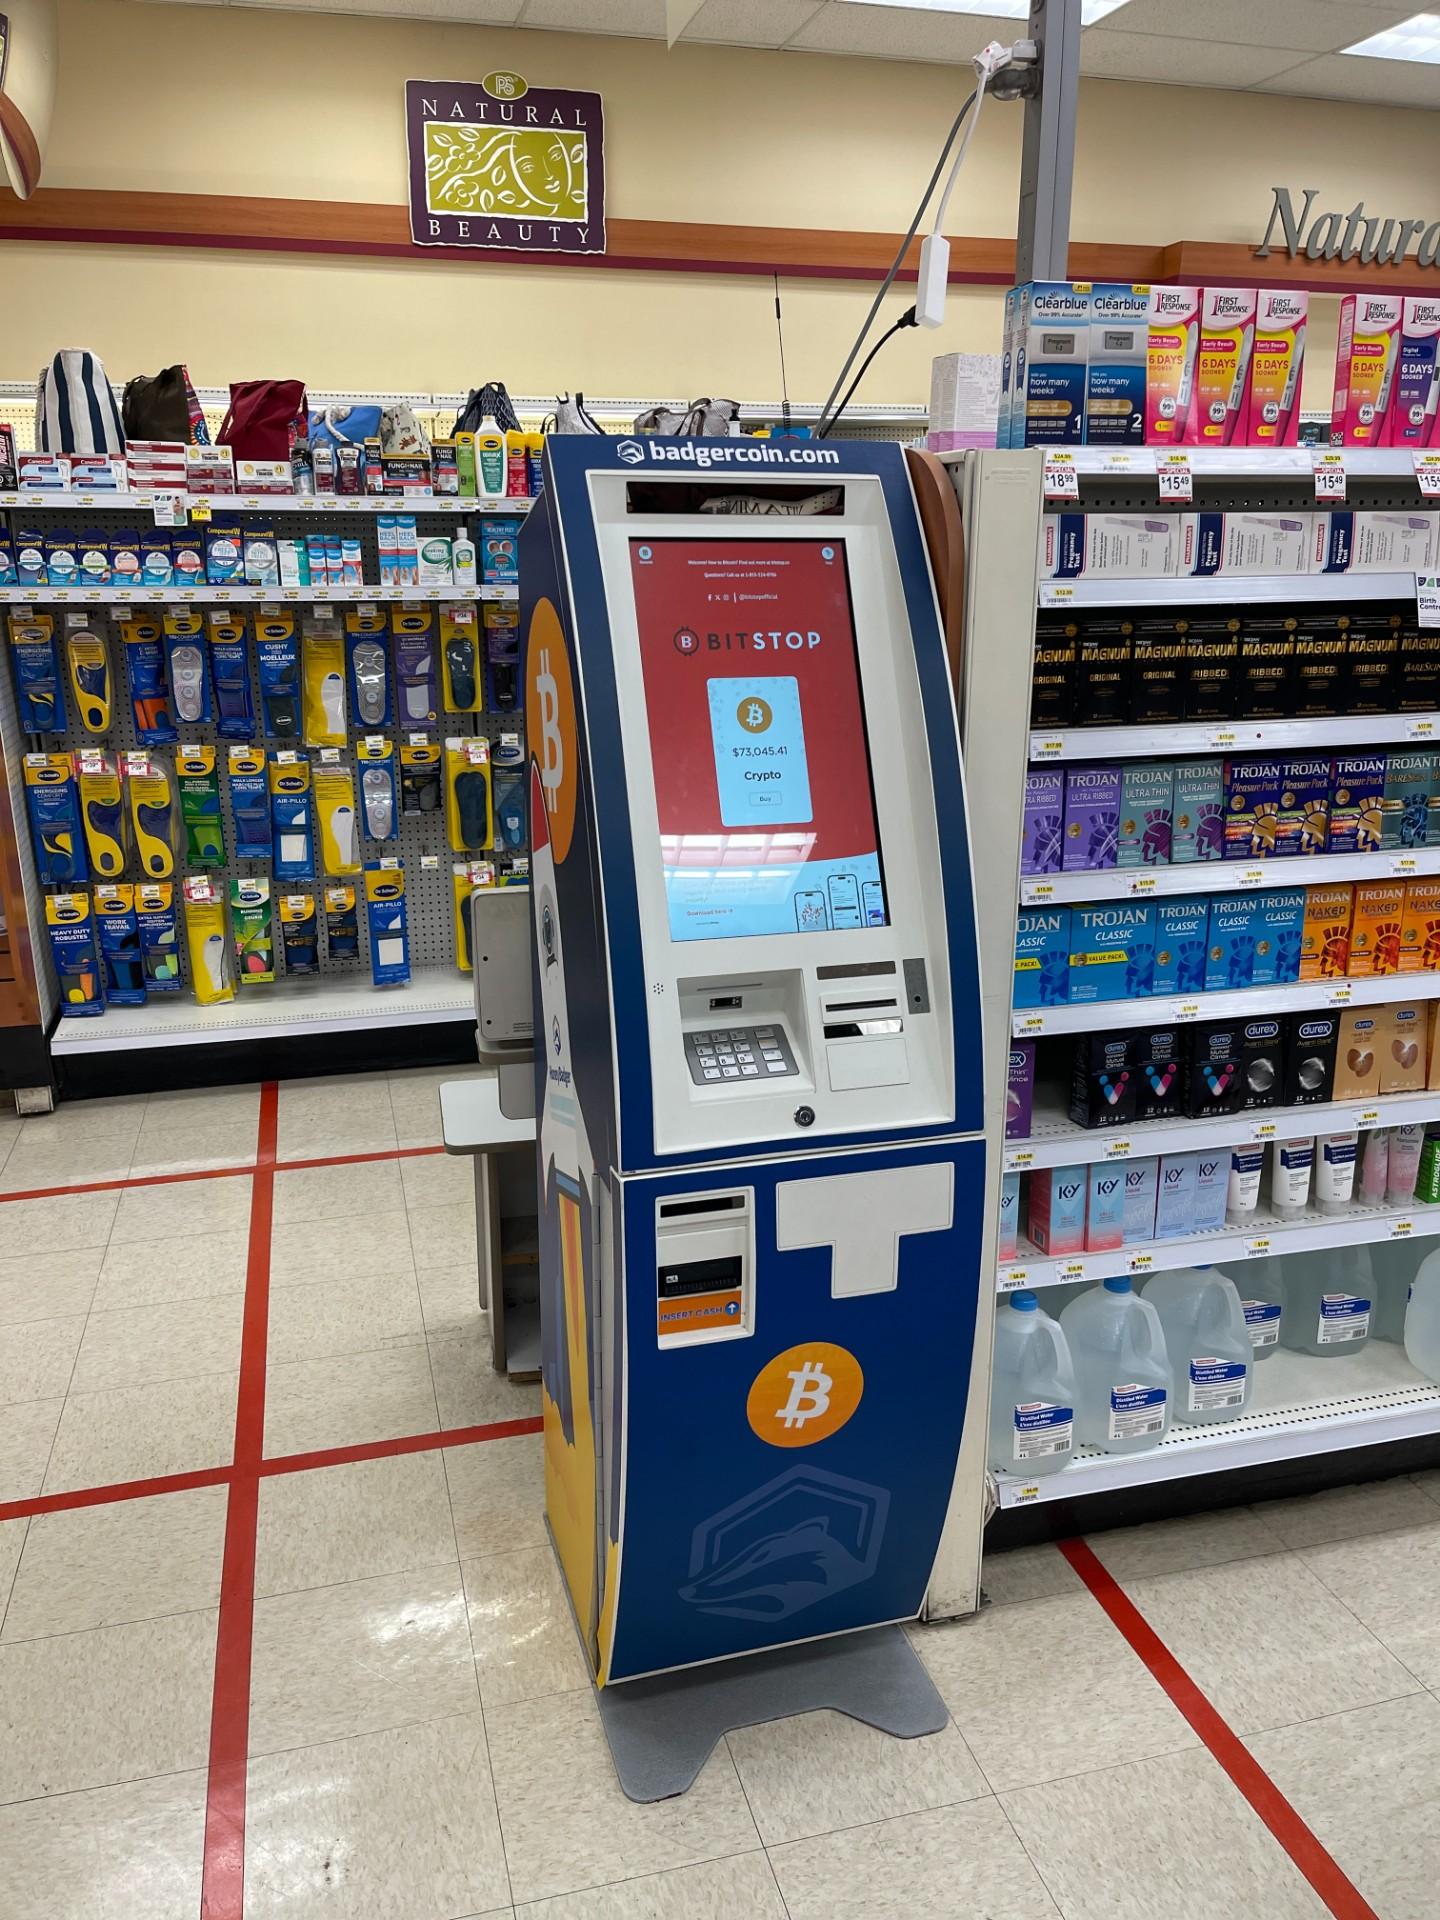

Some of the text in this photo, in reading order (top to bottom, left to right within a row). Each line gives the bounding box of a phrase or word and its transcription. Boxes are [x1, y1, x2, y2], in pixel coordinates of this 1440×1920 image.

[421, 98, 587, 126] NATURAL
[429, 220, 590, 244] BEAUTY
[1034, 296, 1087, 310] Clearblue
[1094, 297, 1147, 311] Clearblue
[1161, 294, 1181, 303] FIRST
[1219, 296, 1238, 305] FIRST
[1272, 298, 1291, 307] FIRST
[1161, 302, 1191, 310] RESPONSE
[1217, 305, 1248, 313] RESPONSE
[1271, 306, 1300, 315] RESPONSE
[1369, 303, 1387, 311] FIRST
[1417, 306, 1436, 314] FIRST
[1368, 310, 1395, 320] RESPONSE
[1416, 313, 1440, 322] RESPONS
[1149, 355, 1183, 364] 6 DAYS
[1202, 359, 1236, 368] 6 DAYS
[1256, 360, 1288, 370] 6 DAYS
[1353, 362, 1384, 372] 6 DAYS
[1402, 364, 1433, 374] 6 DAYS
[1031, 378, 1070, 387] how many
[1091, 377, 1130, 386] how many
[1091, 386, 1114, 394] weeks
[1074, 415, 1081, 428] 1
[1132, 413, 1142, 428] 2
[649, 440, 840, 468] badgercoin.com
[707, 632, 821, 650] BITSTOP
[1349, 639, 1397, 653] MAGNUM
[1134, 645, 1186, 659] MAGNUM
[1186, 644, 1238, 657] MAGNUM
[1242, 643, 1294, 656] MAGNUM
[1296, 641, 1346, 654] MAGNUM
[1082, 648, 1130, 661] MAGNUM
[1250, 667, 1283, 676] RIBBED
[1355, 664, 1387, 672] RIBBED
[732, 746, 788, 758] $73,045.41
[1283, 762, 1330, 776] TROJAN
[1336, 759, 1384, 773] TROJAN
[1385, 756, 1431, 770] TROJAN
[744, 771, 781, 781] Crypto
[1124, 771, 1172, 784] TROJAN
[1176, 767, 1222, 780] TROJAN
[1232, 765, 1280, 779] TROJAN
[1068, 774, 1119, 787] TROJAN
[1281, 778, 1328, 790] Pleasure Pack
[1336, 775, 1383, 787] Pleasure Pack
[1126, 788, 1169, 798] ULTRA THIN
[1179, 782, 1219, 793] ULTRA THIN
[1231, 782, 1278, 793] Pleasure Pack
[1037, 795, 1056, 803] RIBBED
[1071, 791, 1113, 801] ULTRA RIBBED
[1306, 893, 1350, 904] TROJAN
[1359, 888, 1404, 900] TROJAN
[1212, 900, 1257, 913] TROJAN
[1259, 896, 1304, 909] TROJAN
[1361, 903, 1399, 913] NAKED
[1159, 904, 1207, 918] TROJAN
[1265, 911, 1297, 922] CLASSIC
[1307, 906, 1346, 918] NAKED
[1081, 909, 1148, 928] TROJAN
[1218, 916, 1250, 928] CLASSIC
[1165, 921, 1199, 932] CLASSIC
[1095, 929, 1134, 941] CLASSIC
[1019, 960, 1037, 968] PACK!
[1088, 954, 1107, 962] VALUE
[1249, 1024, 1275, 1036] durex
[1302, 1024, 1329, 1035] durex
[661, 1307, 722, 1321] INSERT CASH
